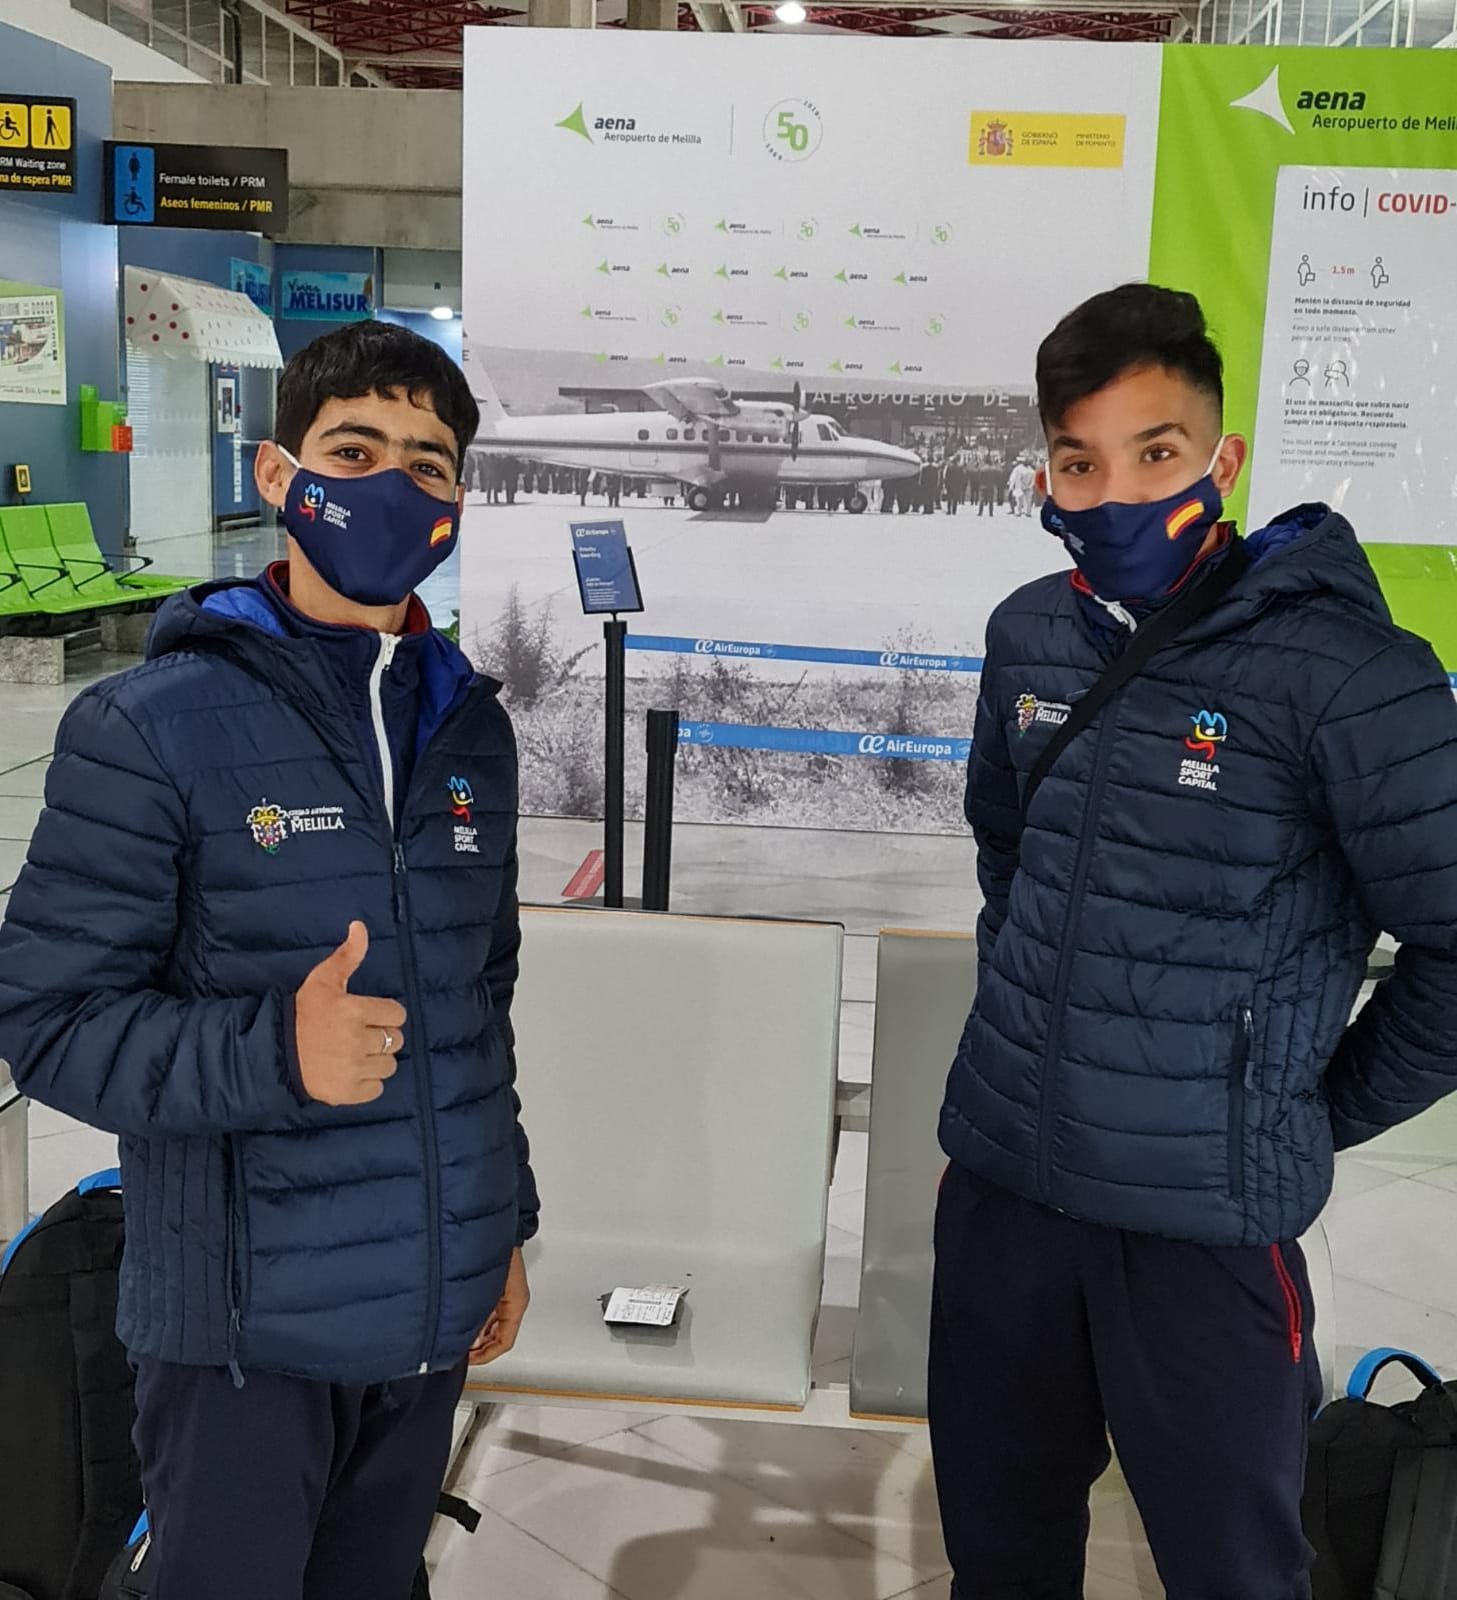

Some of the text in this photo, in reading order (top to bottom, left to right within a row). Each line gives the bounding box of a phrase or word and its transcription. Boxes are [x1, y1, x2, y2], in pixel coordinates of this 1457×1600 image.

[1297, 90, 1366, 110] aena
[594, 117, 636, 130] aena
[1312, 114, 1397, 131] Aeropuerto
[1402, 116, 1420, 130] de
[604, 132, 702, 144] Aeropuerto de Melilla
[776, 111, 809, 151] 50
[15, 157, 45, 171] Waiting
[46, 161, 66, 170] zone
[10, 172, 21, 183] de
[23, 175, 50, 187] espera
[51, 174, 72, 186] PMR
[159, 172, 194, 185] Female
[198, 174, 230, 187] toilets
[240, 177, 265, 188] PRM
[160, 197, 189, 209] Aseos
[191, 197, 240, 211] femeninos
[250, 200, 272, 213] PMR
[1302, 185, 1457, 214] info COVID-
[289, 292, 368, 313] MELISUR
[1295, 297, 1322, 305] Mantén
[1331, 298, 1363, 306] distancia
[1375, 300, 1411, 308] seguridad
[812, 392, 1010, 408] AEROPUERTO DE
[1355, 401, 1368, 409] que
[1333, 420, 1363, 428] etiqueta
[714, 643, 761, 656] AirEuropa
[899, 655, 947, 668] AirEuropa
[886, 739, 952, 756] AirEuropa
[1179, 767, 1212, 780] SPORT
[1181, 759, 1220, 774] MELILLA
[1178, 776, 1217, 791] CAPITAL
[290, 816, 345, 833] MELILLA
[454, 825, 478, 835] MELILLA
[454, 834, 474, 844] SPORT
[454, 842, 480, 853] CAPITAL
